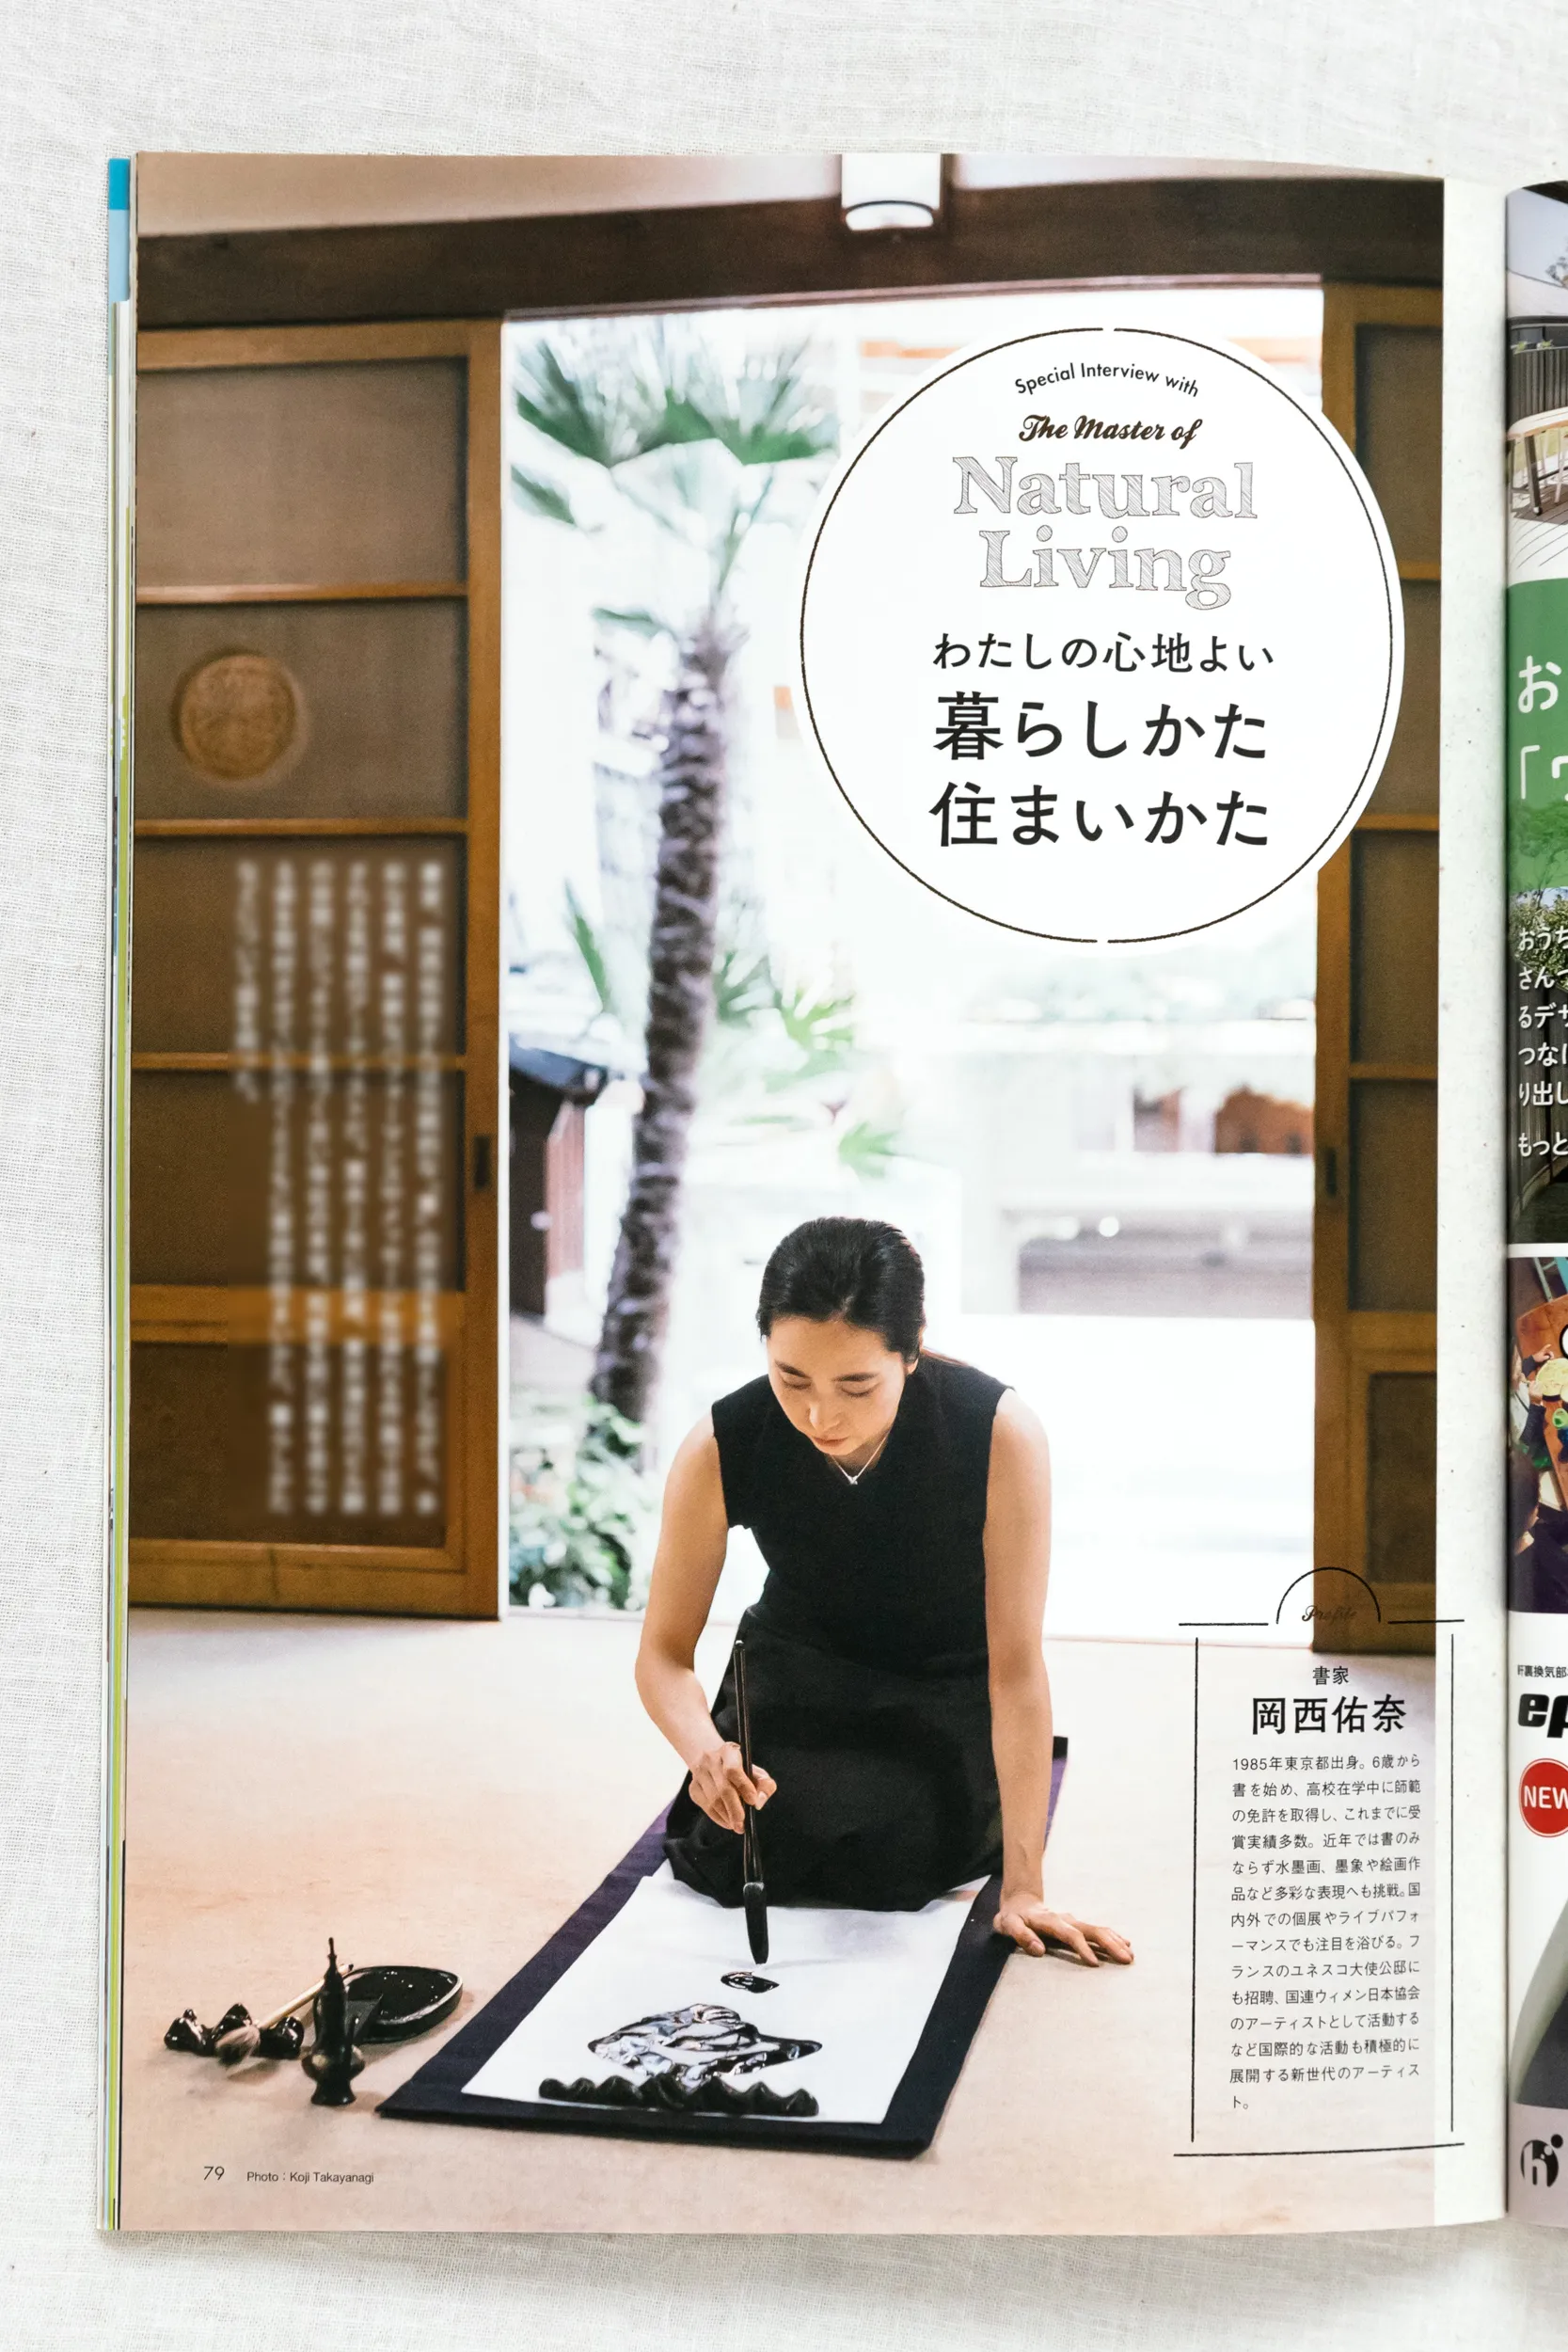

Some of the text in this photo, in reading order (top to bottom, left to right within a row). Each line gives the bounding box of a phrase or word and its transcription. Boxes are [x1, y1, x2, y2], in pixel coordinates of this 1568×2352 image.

[1015, 362, 1199, 397] Special Interview with
[1019, 414, 1204, 450] The Master of
[952, 455, 1259, 519] Natural
[978, 524, 1232, 611] Living
[932, 631, 1274, 673] わたしの心地よい
[933, 691, 1266, 760] 暮らしかた
[928, 781, 1268, 848] 住まいかた
[1518, 1041, 1568, 1067] つな
[1312, 1665, 1350, 1686] 書家
[1252, 1693, 1407, 1736] 岡西佑奈
[203, 2166, 225, 2181] 79
[246, 2171, 278, 2183] Photo
[290, 2171, 310, 2184] Koji
[313, 2171, 374, 2185] Takayanagi
